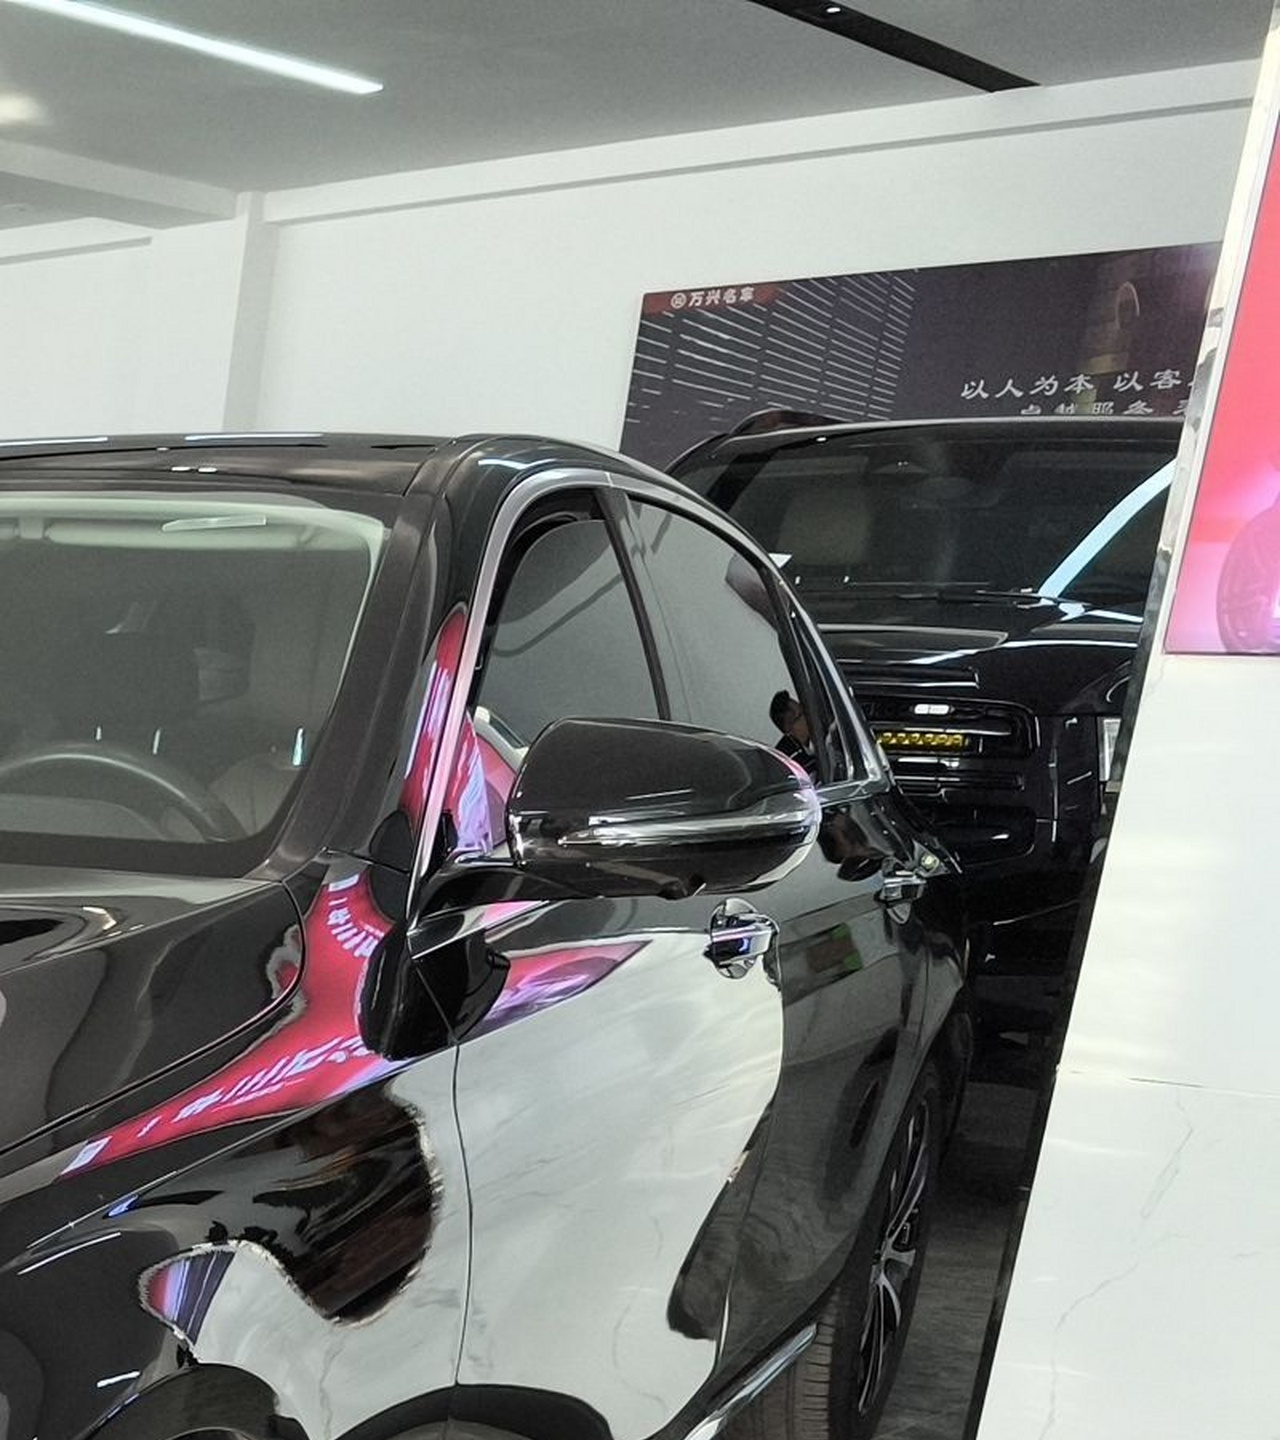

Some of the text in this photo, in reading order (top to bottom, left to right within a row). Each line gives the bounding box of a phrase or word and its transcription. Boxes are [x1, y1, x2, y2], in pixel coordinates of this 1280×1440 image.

[960, 369, 1197, 400] 以人为本 以客
